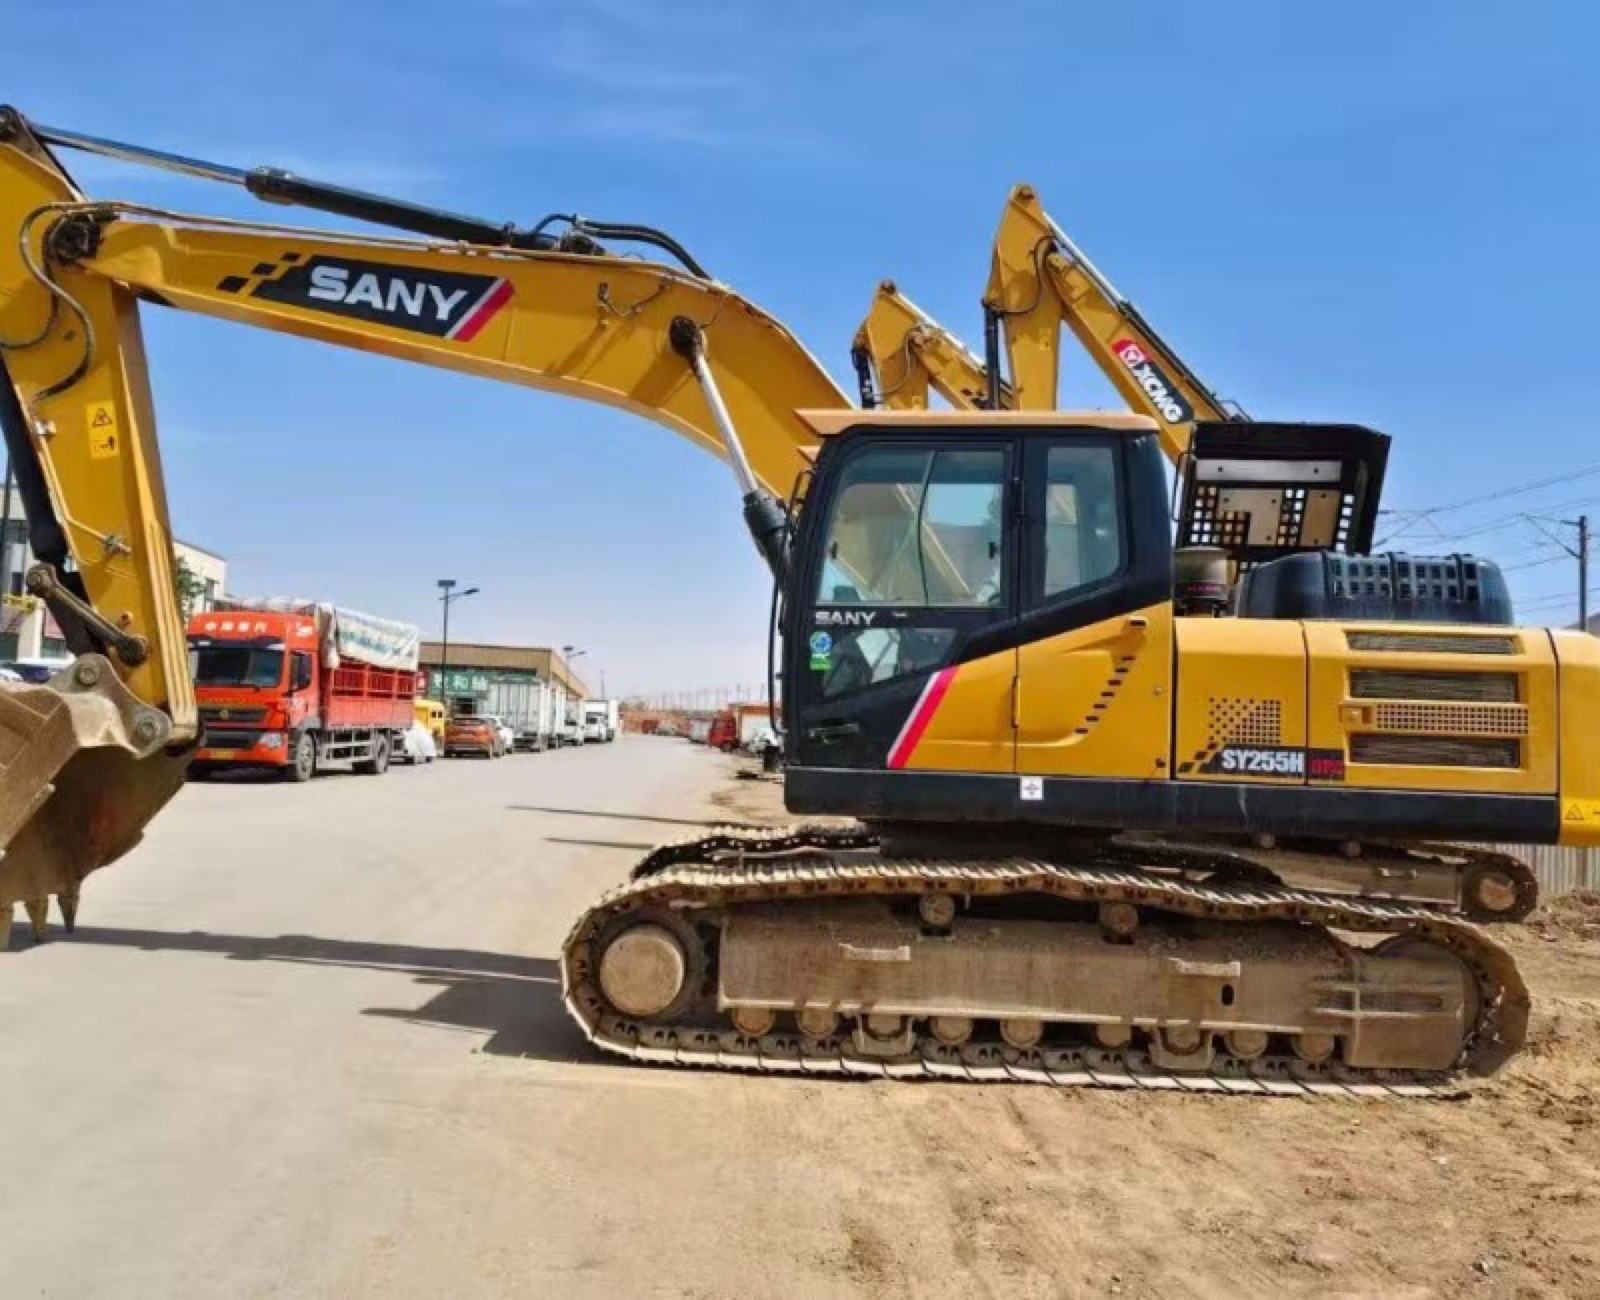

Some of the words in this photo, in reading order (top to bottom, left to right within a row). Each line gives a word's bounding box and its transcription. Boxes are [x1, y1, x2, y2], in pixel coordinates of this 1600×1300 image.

[307, 265, 468, 321] SANY
[1132, 363, 1183, 422] XCMG
[815, 610, 877, 626] SANY
[1221, 749, 1305, 773] SY255H
